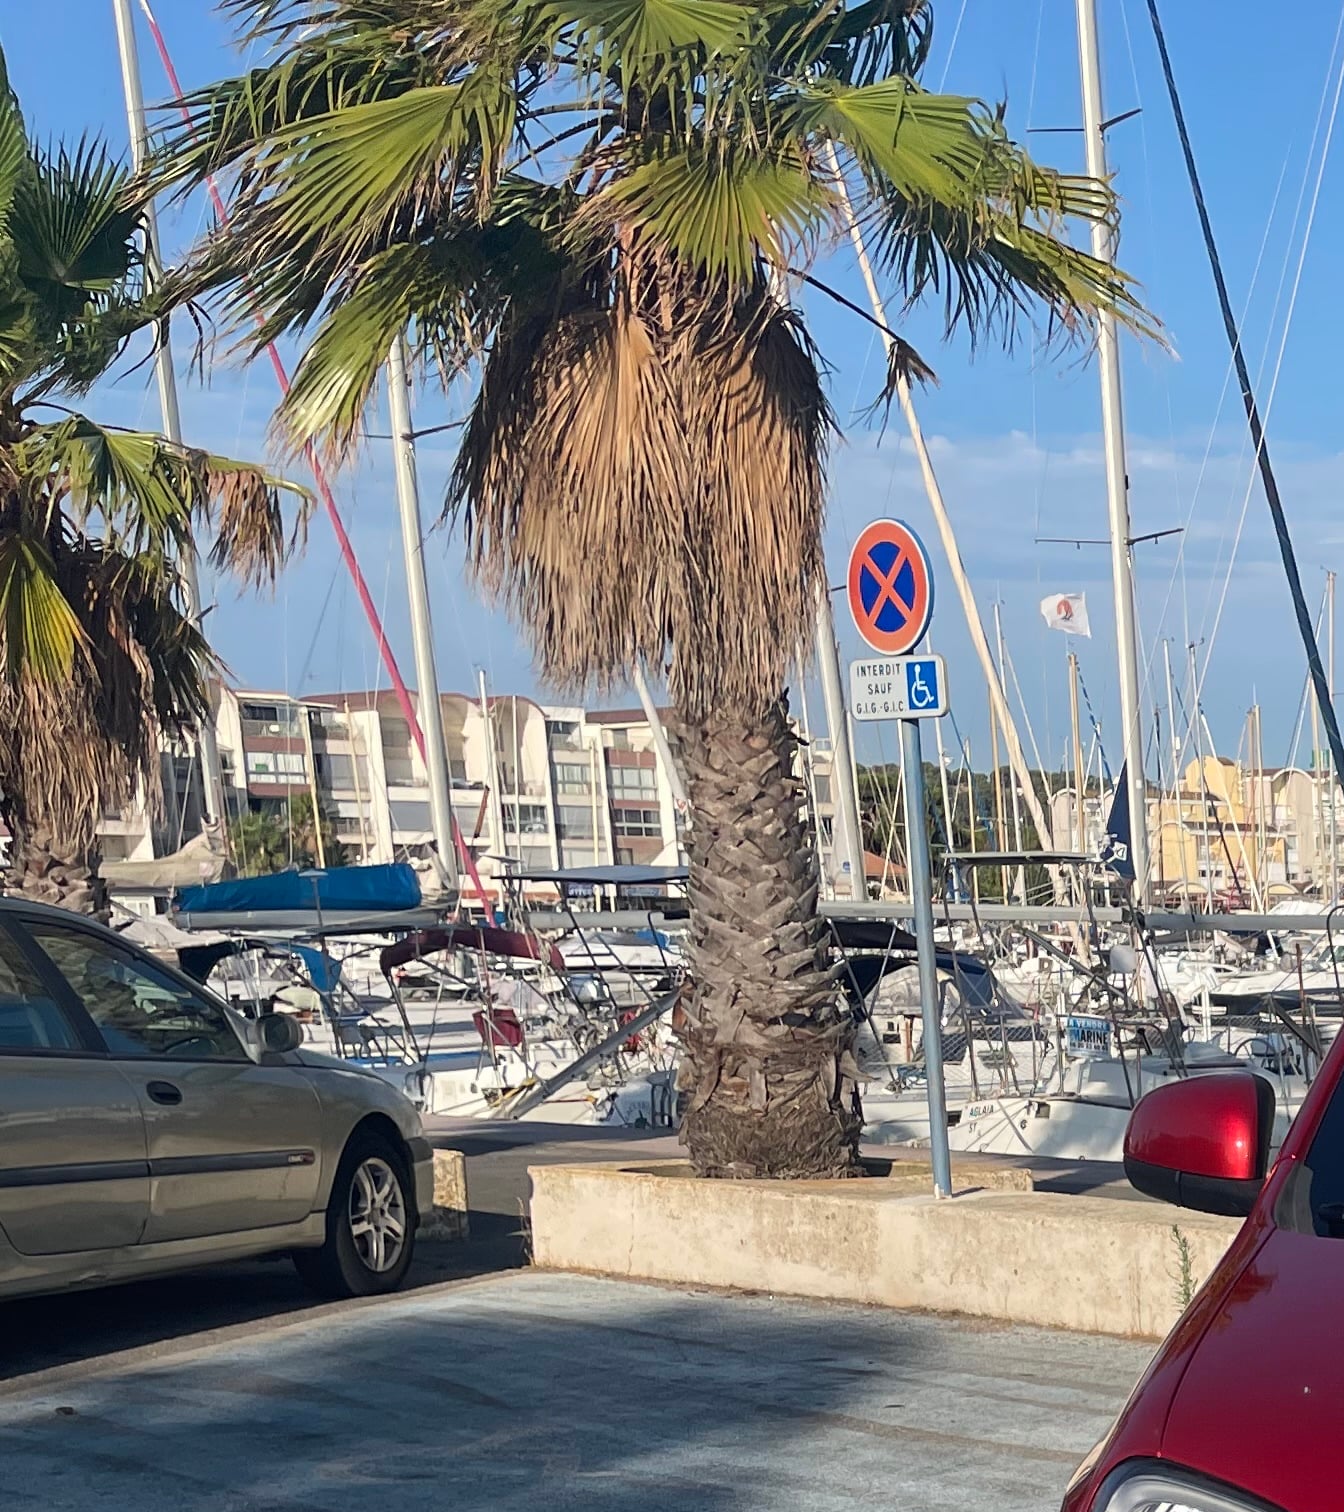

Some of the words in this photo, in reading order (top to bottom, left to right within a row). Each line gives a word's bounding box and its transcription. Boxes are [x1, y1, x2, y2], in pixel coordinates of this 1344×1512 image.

[856, 663, 901, 677] INTERDIT
[868, 683, 892, 695] SAUF
[856, 701, 907, 714] G.I.G.-G.I.C.
